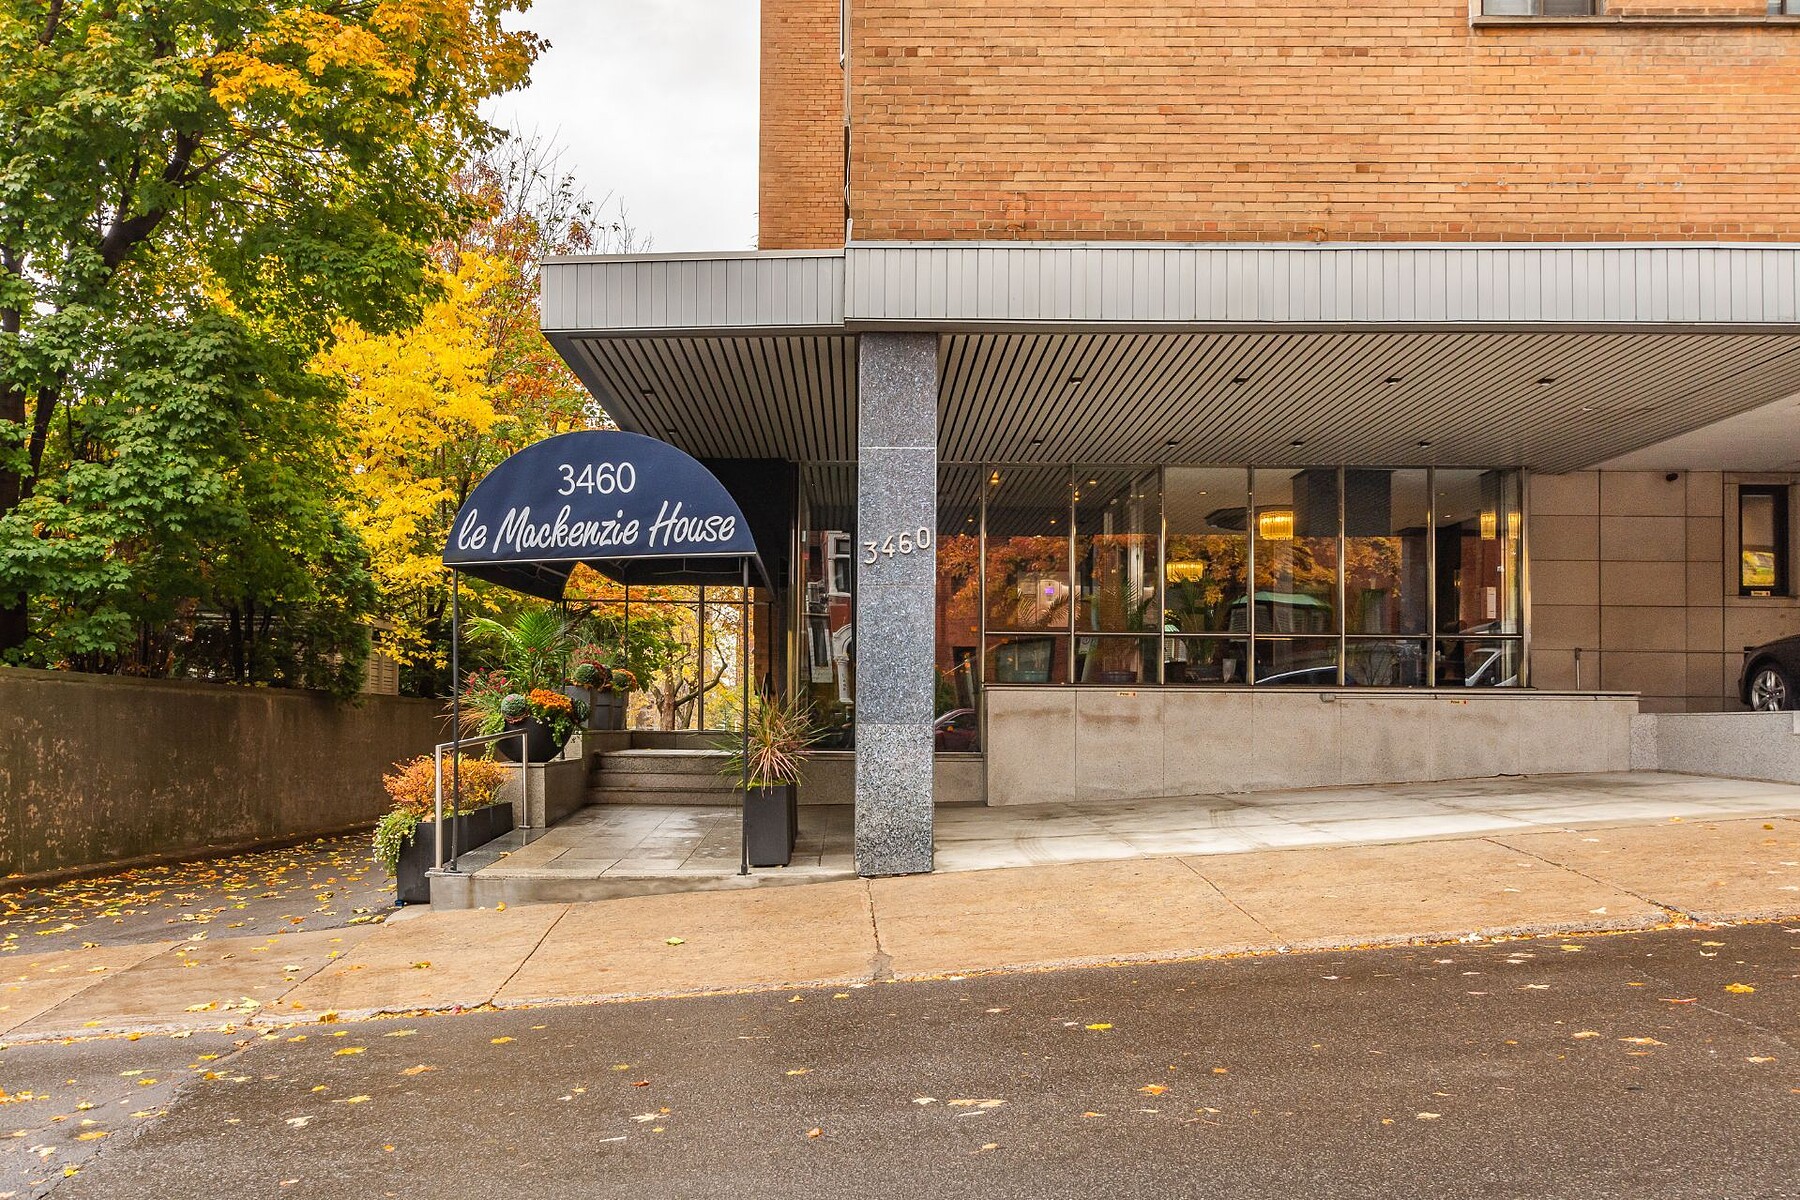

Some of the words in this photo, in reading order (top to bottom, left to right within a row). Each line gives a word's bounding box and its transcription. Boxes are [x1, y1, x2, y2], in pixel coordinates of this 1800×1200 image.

[558, 462, 636, 495] 3460
[458, 508, 488, 550] le
[492, 504, 640, 554] Mackenzie
[649, 500, 736, 548] House
[863, 526, 931, 564] 3460
